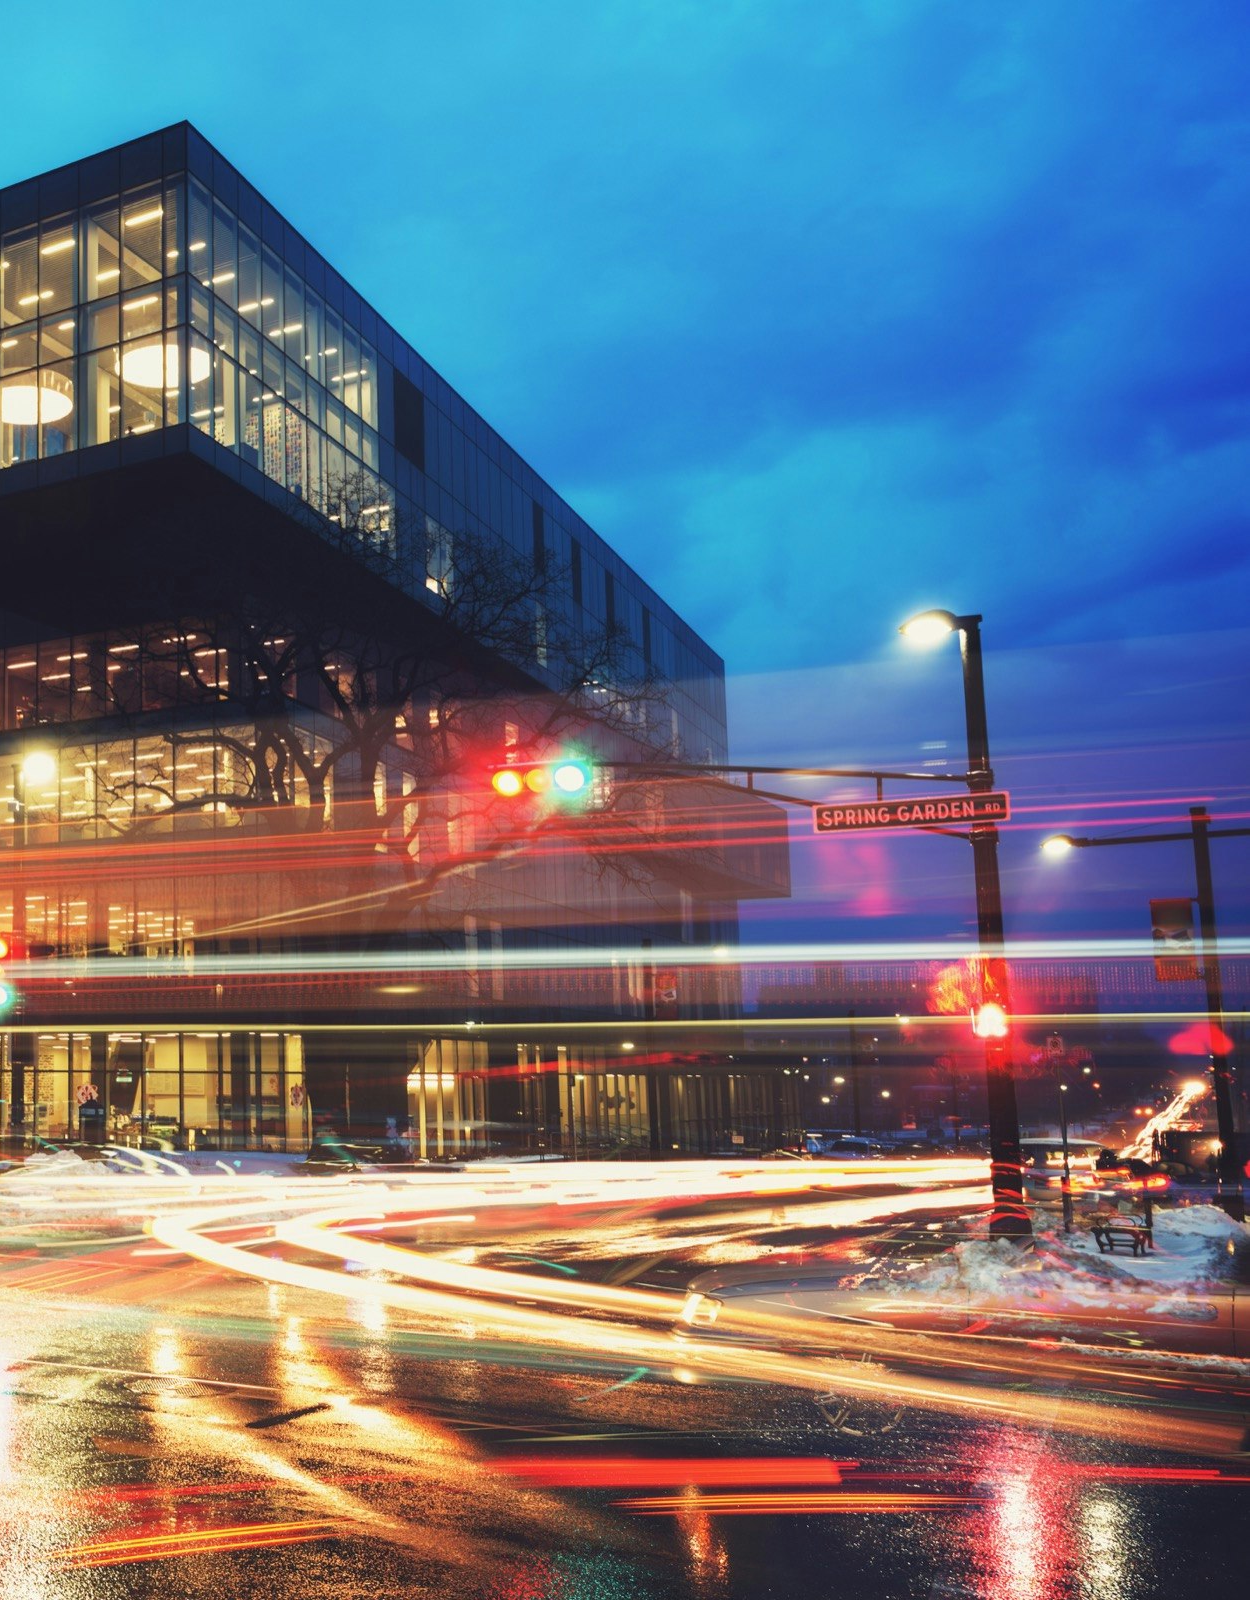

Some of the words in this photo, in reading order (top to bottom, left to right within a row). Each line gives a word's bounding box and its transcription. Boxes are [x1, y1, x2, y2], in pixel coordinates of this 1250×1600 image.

[821, 807, 890, 827] SPRING
[896, 800, 976, 822] GARDEN
[984, 802, 1000, 812] RD
